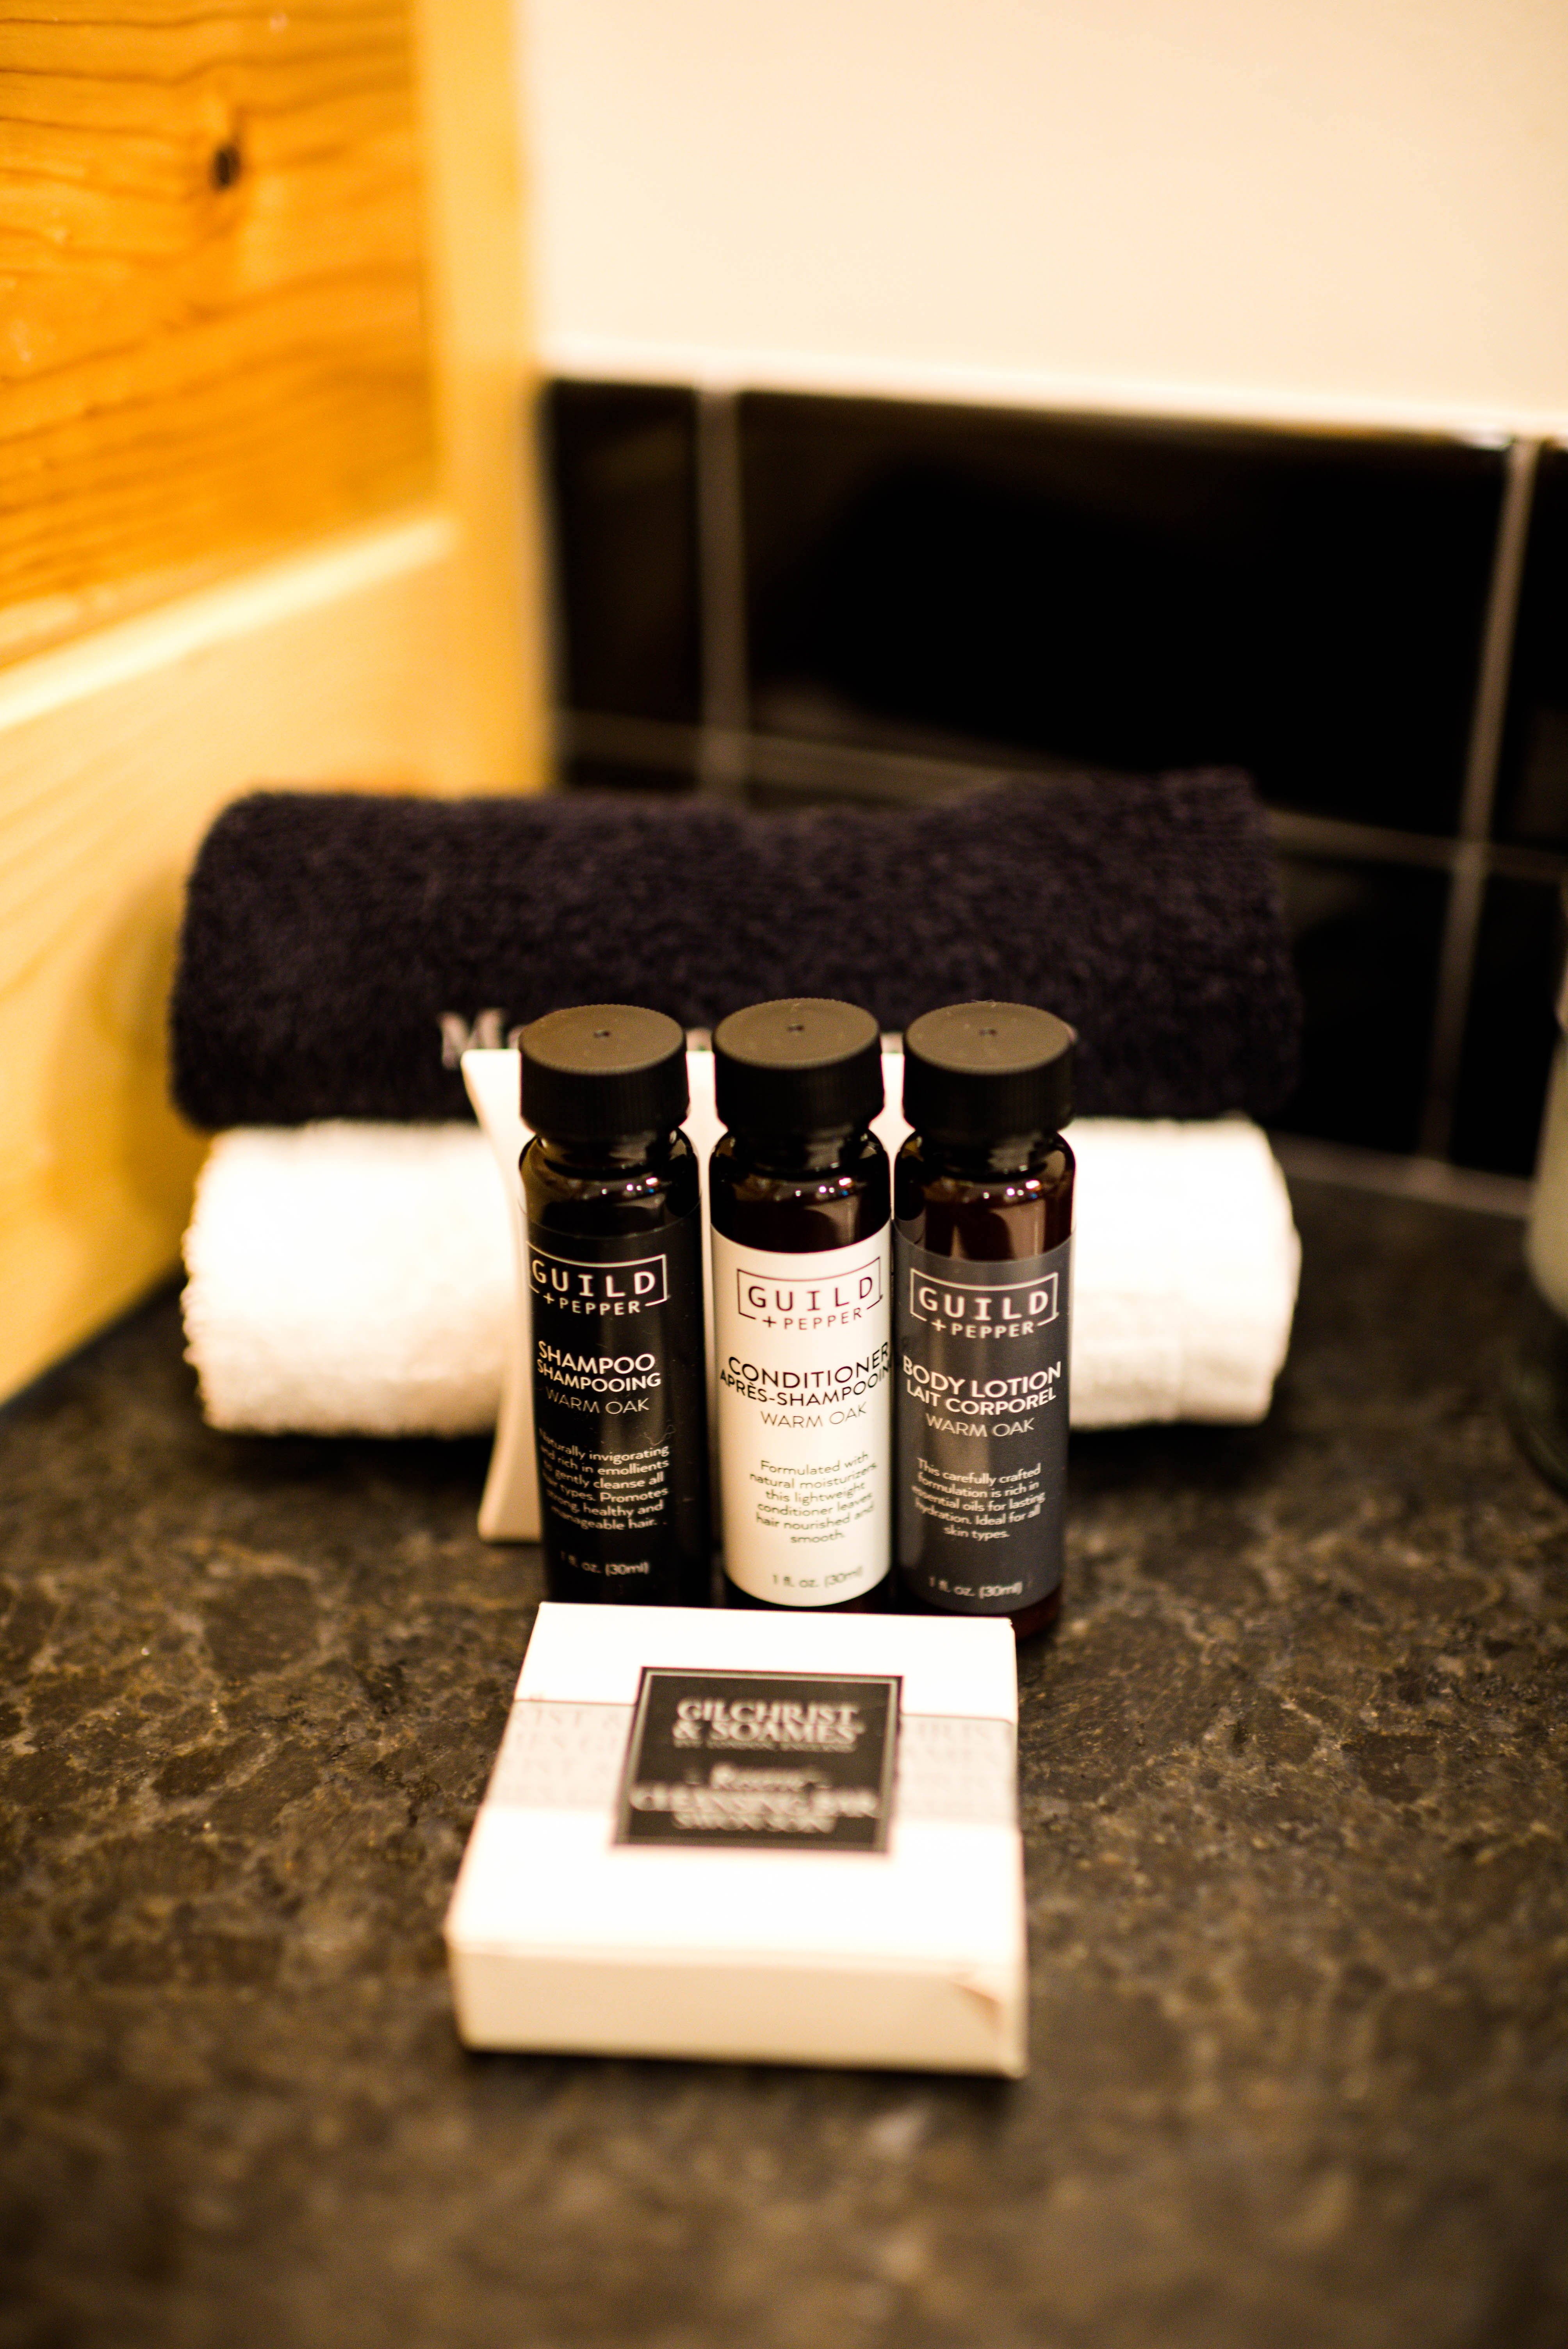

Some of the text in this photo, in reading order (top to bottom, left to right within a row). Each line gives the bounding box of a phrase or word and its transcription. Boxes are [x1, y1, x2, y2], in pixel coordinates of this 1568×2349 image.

[532, 1260, 655, 1297] GUILD
[748, 1277, 873, 1311] GUILD
[919, 1287, 1048, 1321] GUILD
[538, 1341, 655, 1374] SHAMPOO
[729, 1342, 888, 1388] CONDITIONER
[537, 1359, 661, 1392] SHAMPOOING
[720, 1363, 890, 1406] APRÈS-SHAMPOOIN
[903, 1355, 1061, 1398] BODY LOTION
[546, 1387, 649, 1414] WARM OAK
[907, 1379, 1056, 1415] LAIT CORPOREL
[761, 1402, 866, 1428] WARM OAK
[925, 1413, 1035, 1437] WARM OAK
[558, 1456, 578, 1470] rich
[582, 1462, 593, 1473] in
[597, 1460, 670, 1475] emollients
[589, 1446, 669, 1465] invigorating
[761, 1451, 868, 1475] Formulated with
[555, 1469, 590, 1488] gently
[593, 1478, 645, 1489] cleanse
[649, 1471, 664, 1485] all
[750, 1473, 795, 1488] natural
[917, 1457, 1041, 1486] This carefully crafted
[600, 1488, 670, 1503] Promotes
[766, 1481, 865, 1506] this lightweight
[918, 1472, 1039, 1498] formulation is rich in
[583, 1502, 634, 1518] healthy
[637, 1499, 663, 1514] and
[757, 1492, 872, 1516] conditioner leaves
[963, 1501, 985, 1512] oils
[988, 1501, 1007, 1512] for
[1009, 1492, 1046, 1510] lasting
[976, 1513, 1006, 1526] Ideal
[1008, 1511, 1026, 1523] for
[1027, 1503, 1041, 1518] all
[756, 1501, 874, 1530] hair nourished and
[943, 1524, 969, 1538] skin
[676, 1697, 859, 1725] GILCHRIST
[672, 1721, 702, 1740] &
